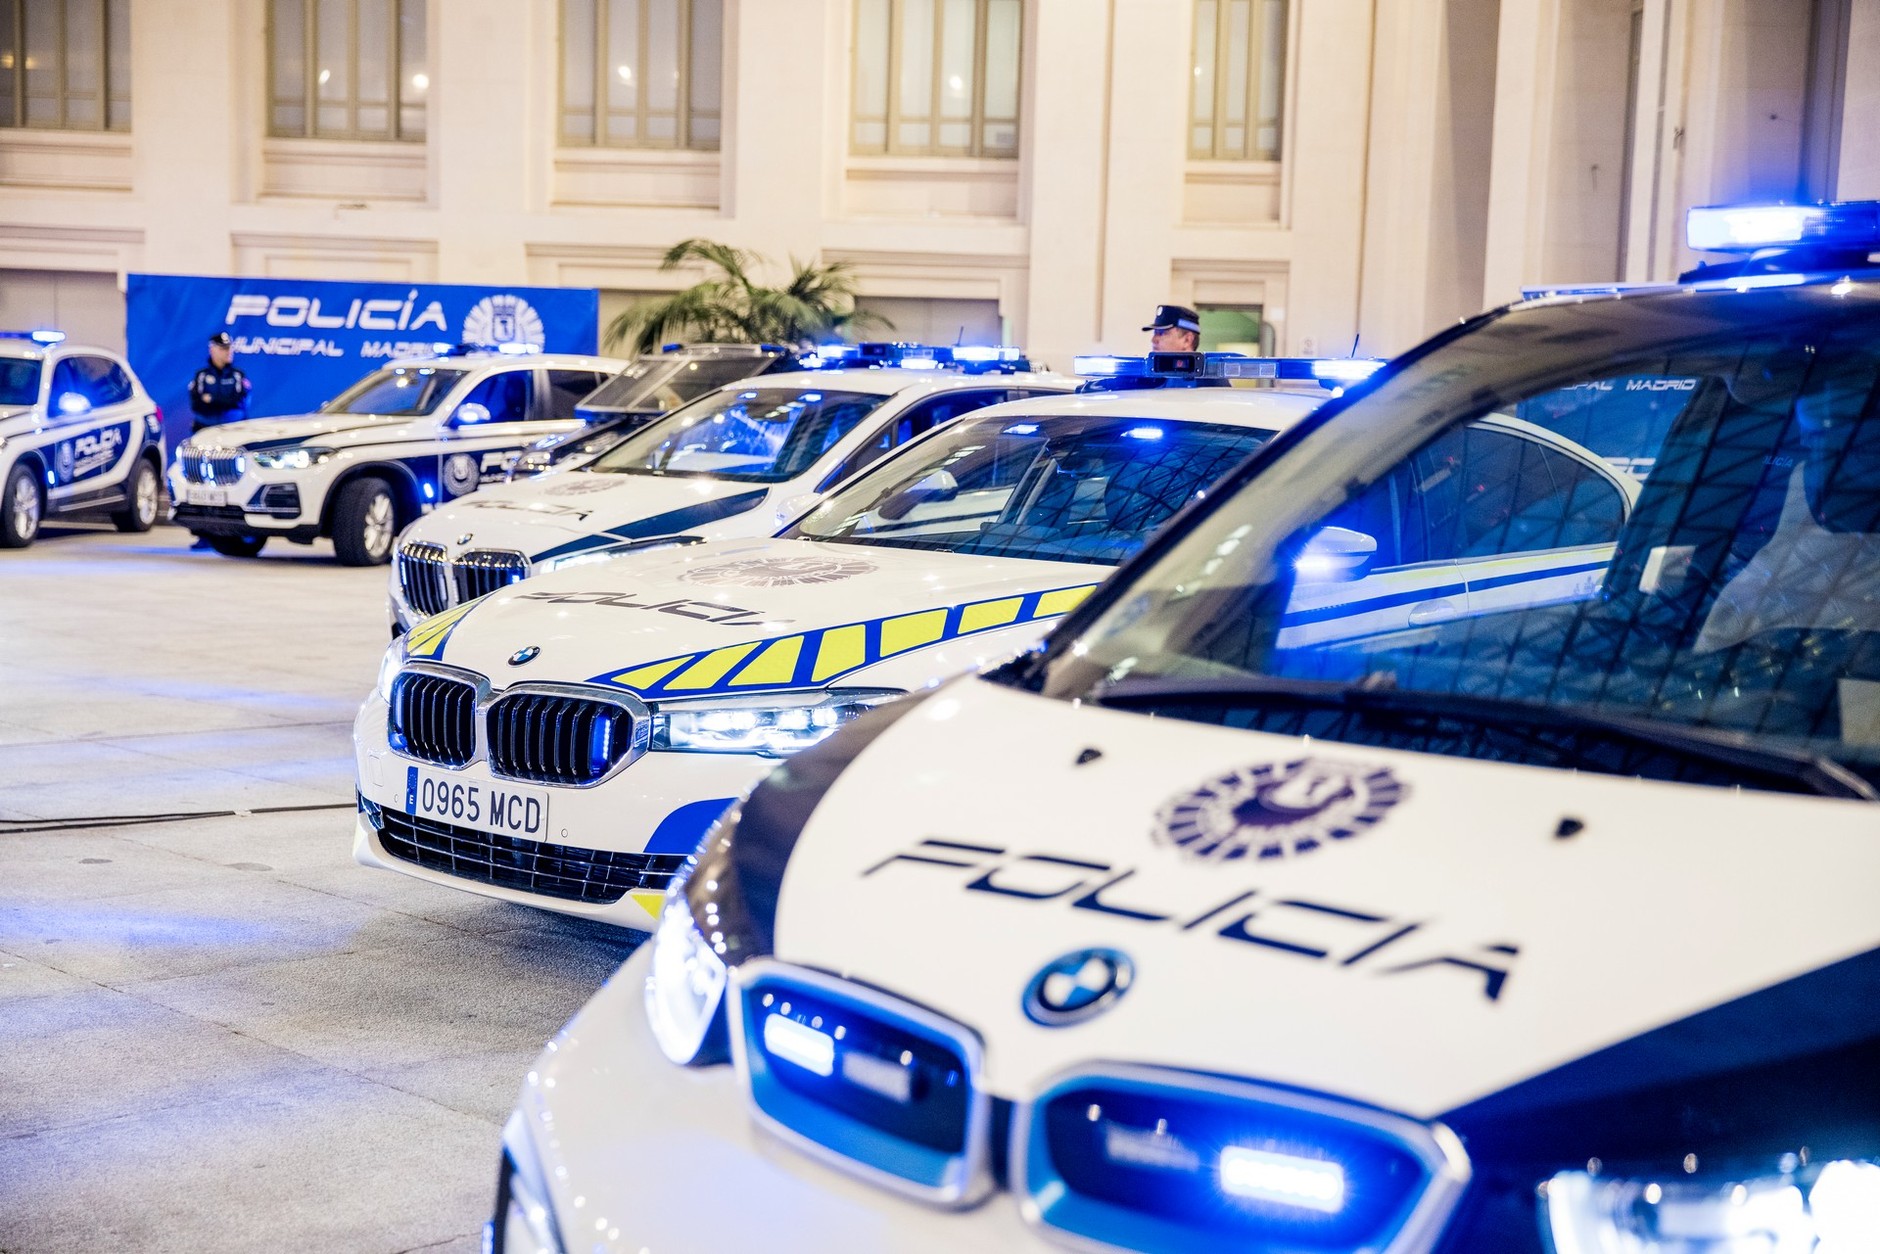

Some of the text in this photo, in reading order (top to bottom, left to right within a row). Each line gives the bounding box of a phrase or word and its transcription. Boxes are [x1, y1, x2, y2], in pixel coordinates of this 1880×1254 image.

[225, 288, 448, 332] POLICÍA
[1626, 379, 1697, 391] MADRID
[422, 778, 480, 822] 0965
[490, 790, 541, 833] MCD
